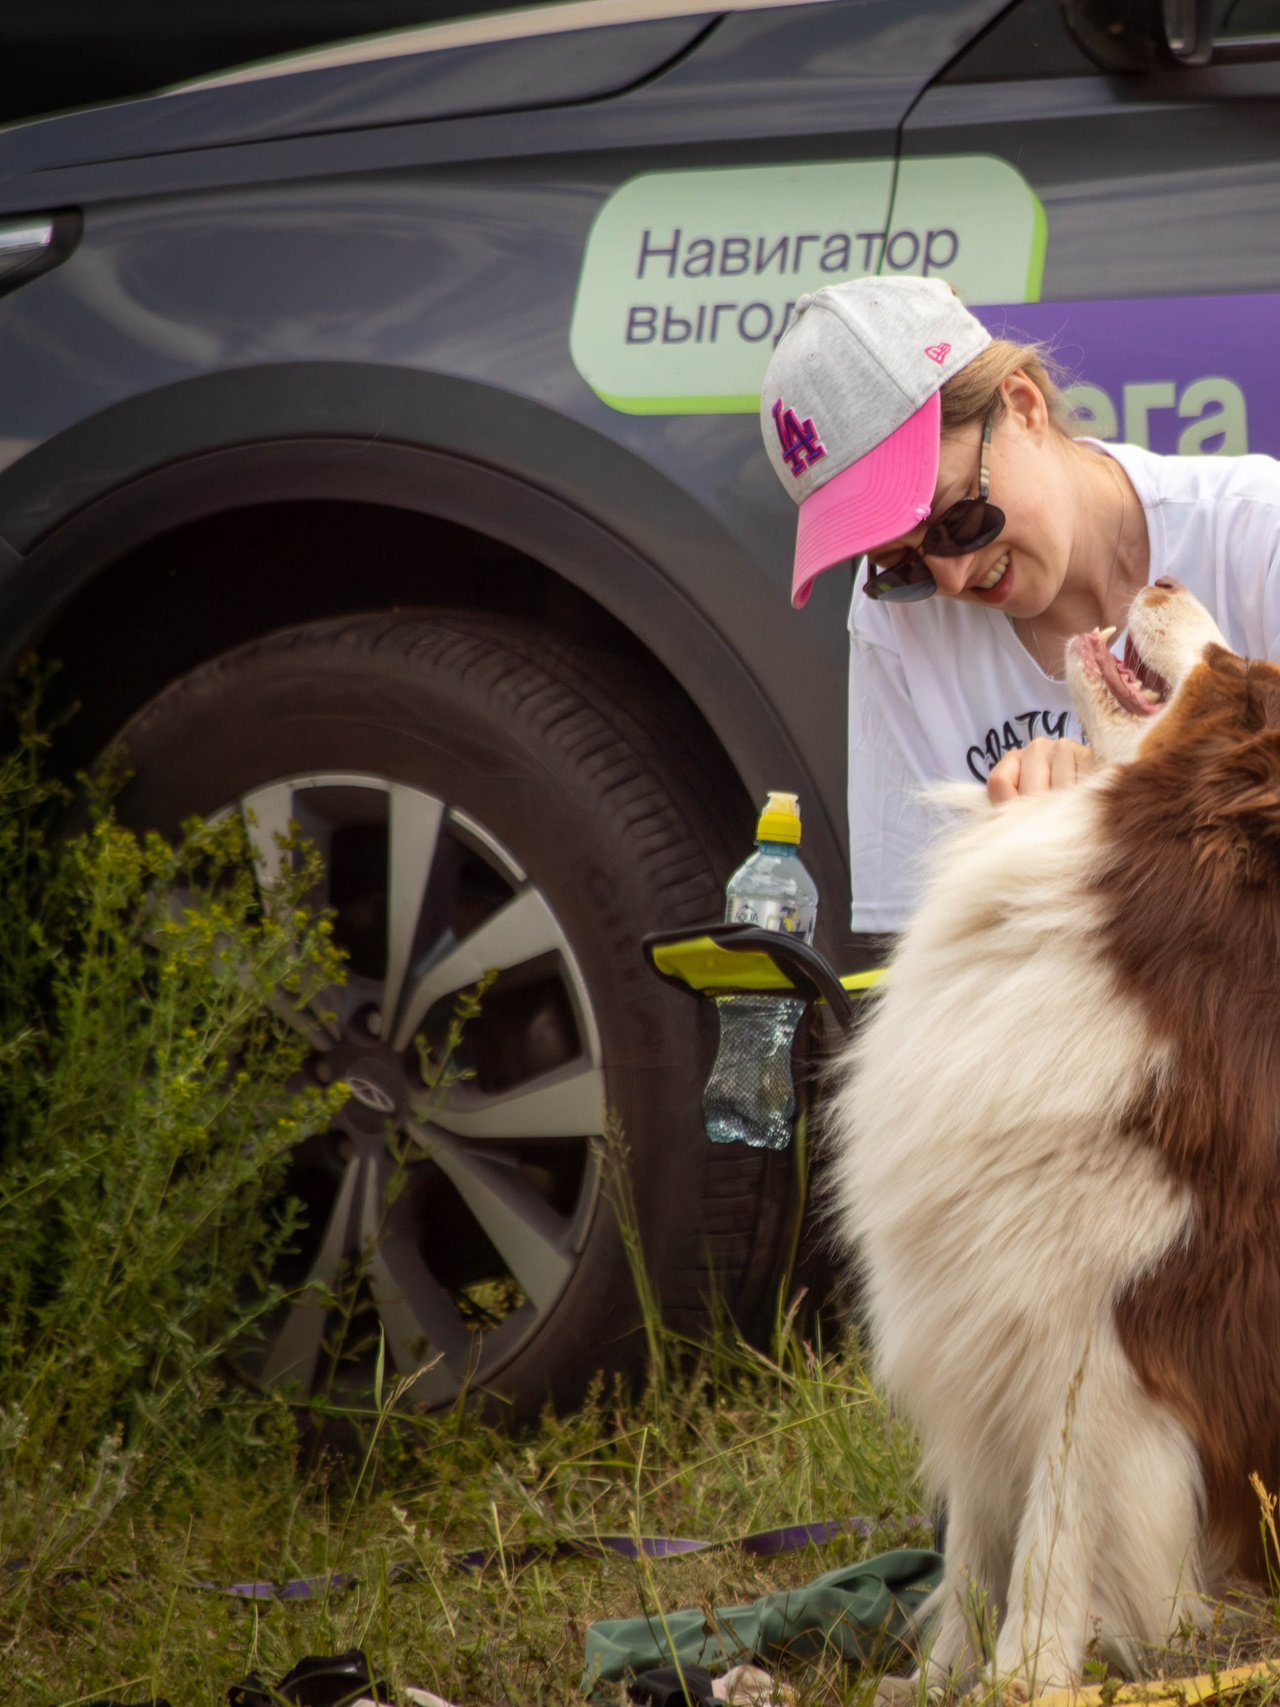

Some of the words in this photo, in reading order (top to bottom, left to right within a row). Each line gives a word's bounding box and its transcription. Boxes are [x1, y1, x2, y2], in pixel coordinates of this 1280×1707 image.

[636, 228, 960, 278] Навигатор
[771, 398, 828, 478] LA
[1057, 375, 1249, 456] ега
